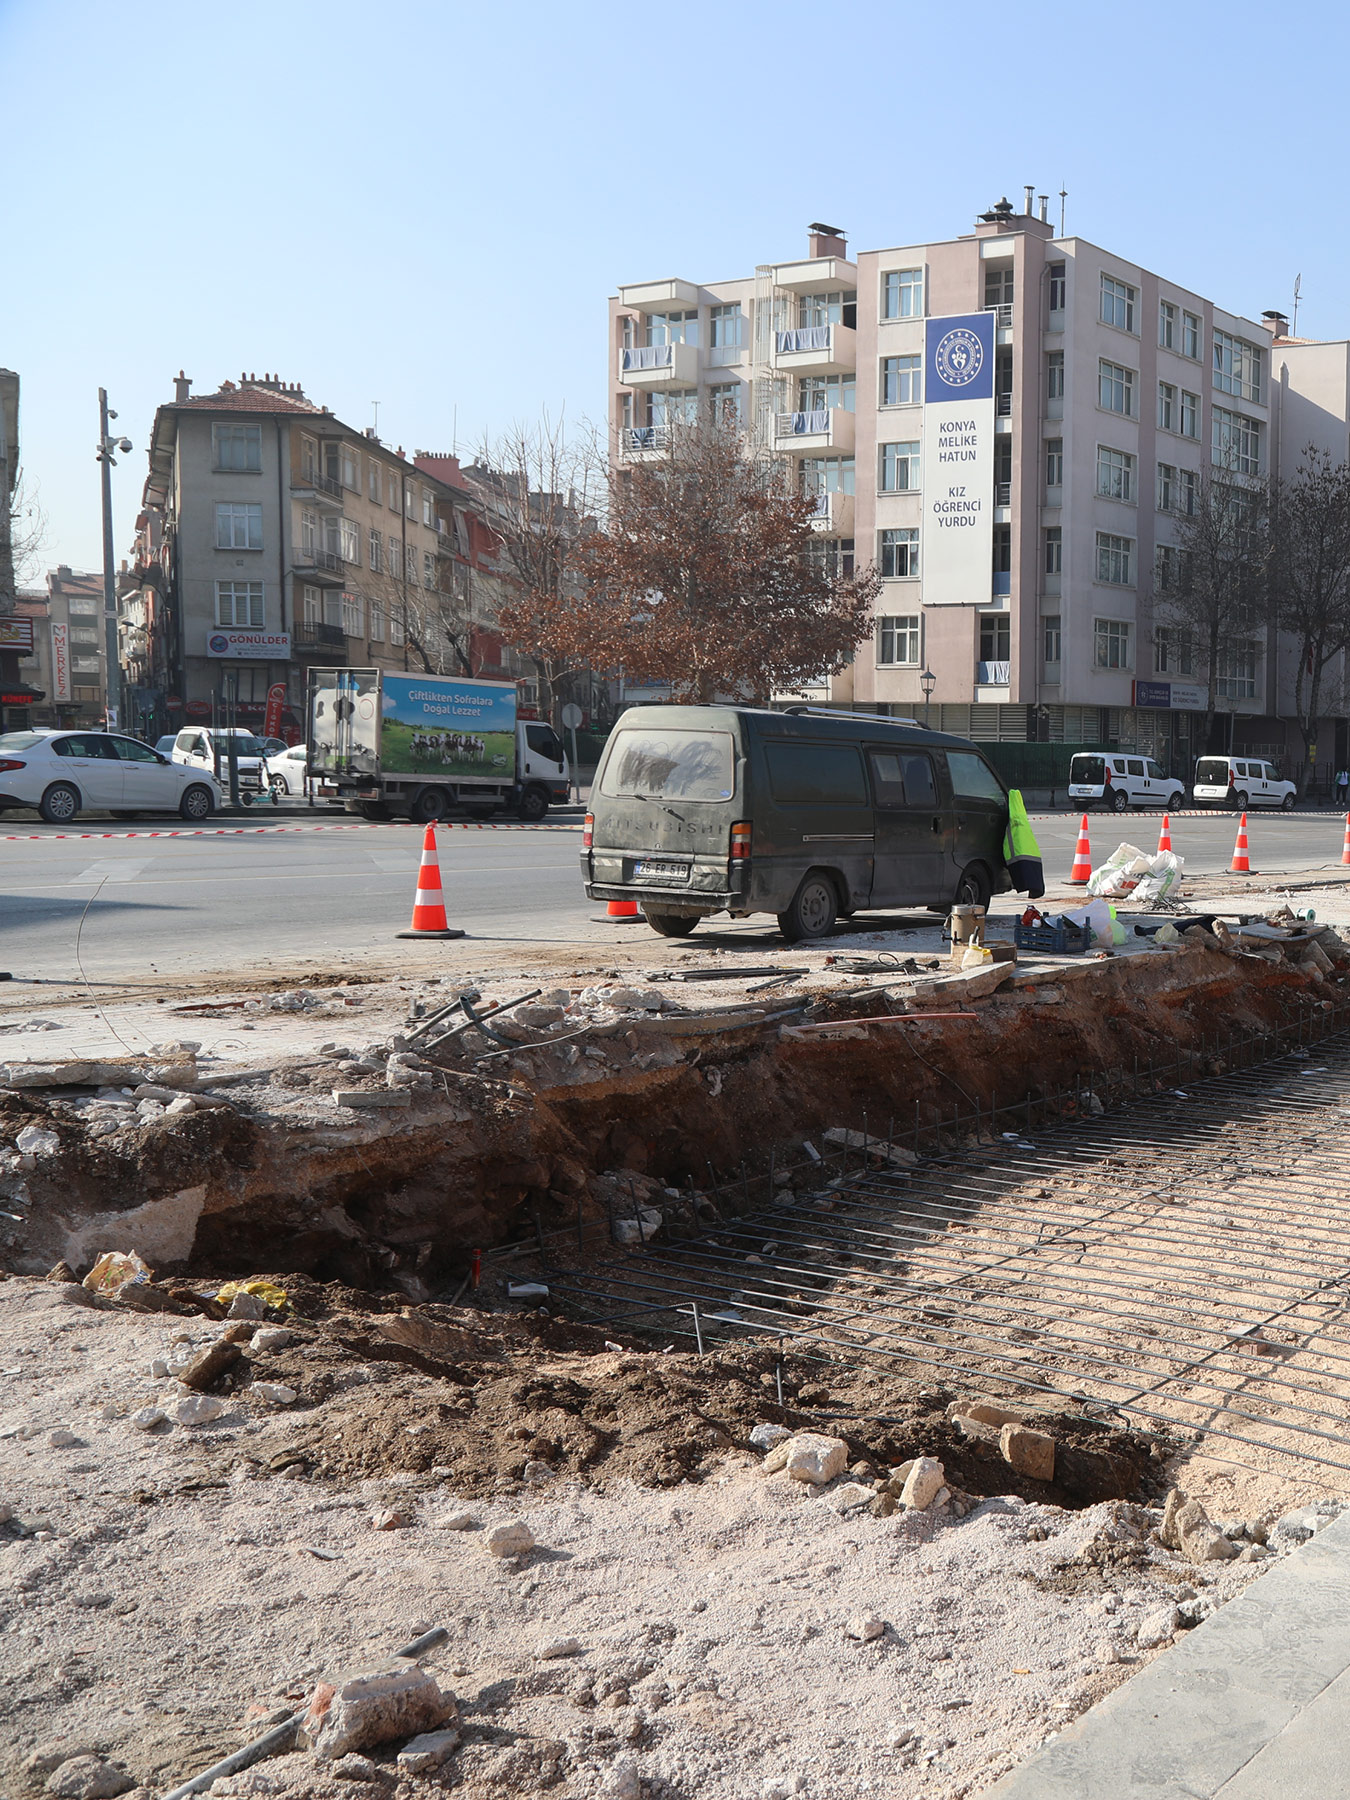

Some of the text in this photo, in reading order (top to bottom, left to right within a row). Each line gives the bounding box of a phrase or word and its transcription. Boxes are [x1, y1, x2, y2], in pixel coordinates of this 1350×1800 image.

[940, 421, 976, 432] KONYA
[939, 434, 977, 447] MELİKE
[939, 451, 976, 462] HATUN
[949, 487, 966, 497] KIZ
[933, 499, 981, 513] ÖĞRENCİ
[938, 516, 976, 527] YURDU
[230, 634, 288, 644] GÖNÜLDER
[55, 637, 66, 695] MERKEZ
[408, 690, 493, 706] Çiftlikten Sofralara
[423, 703, 481, 716] Doğal Lezzet
[640, 862, 687, 876] 26 ER 519
